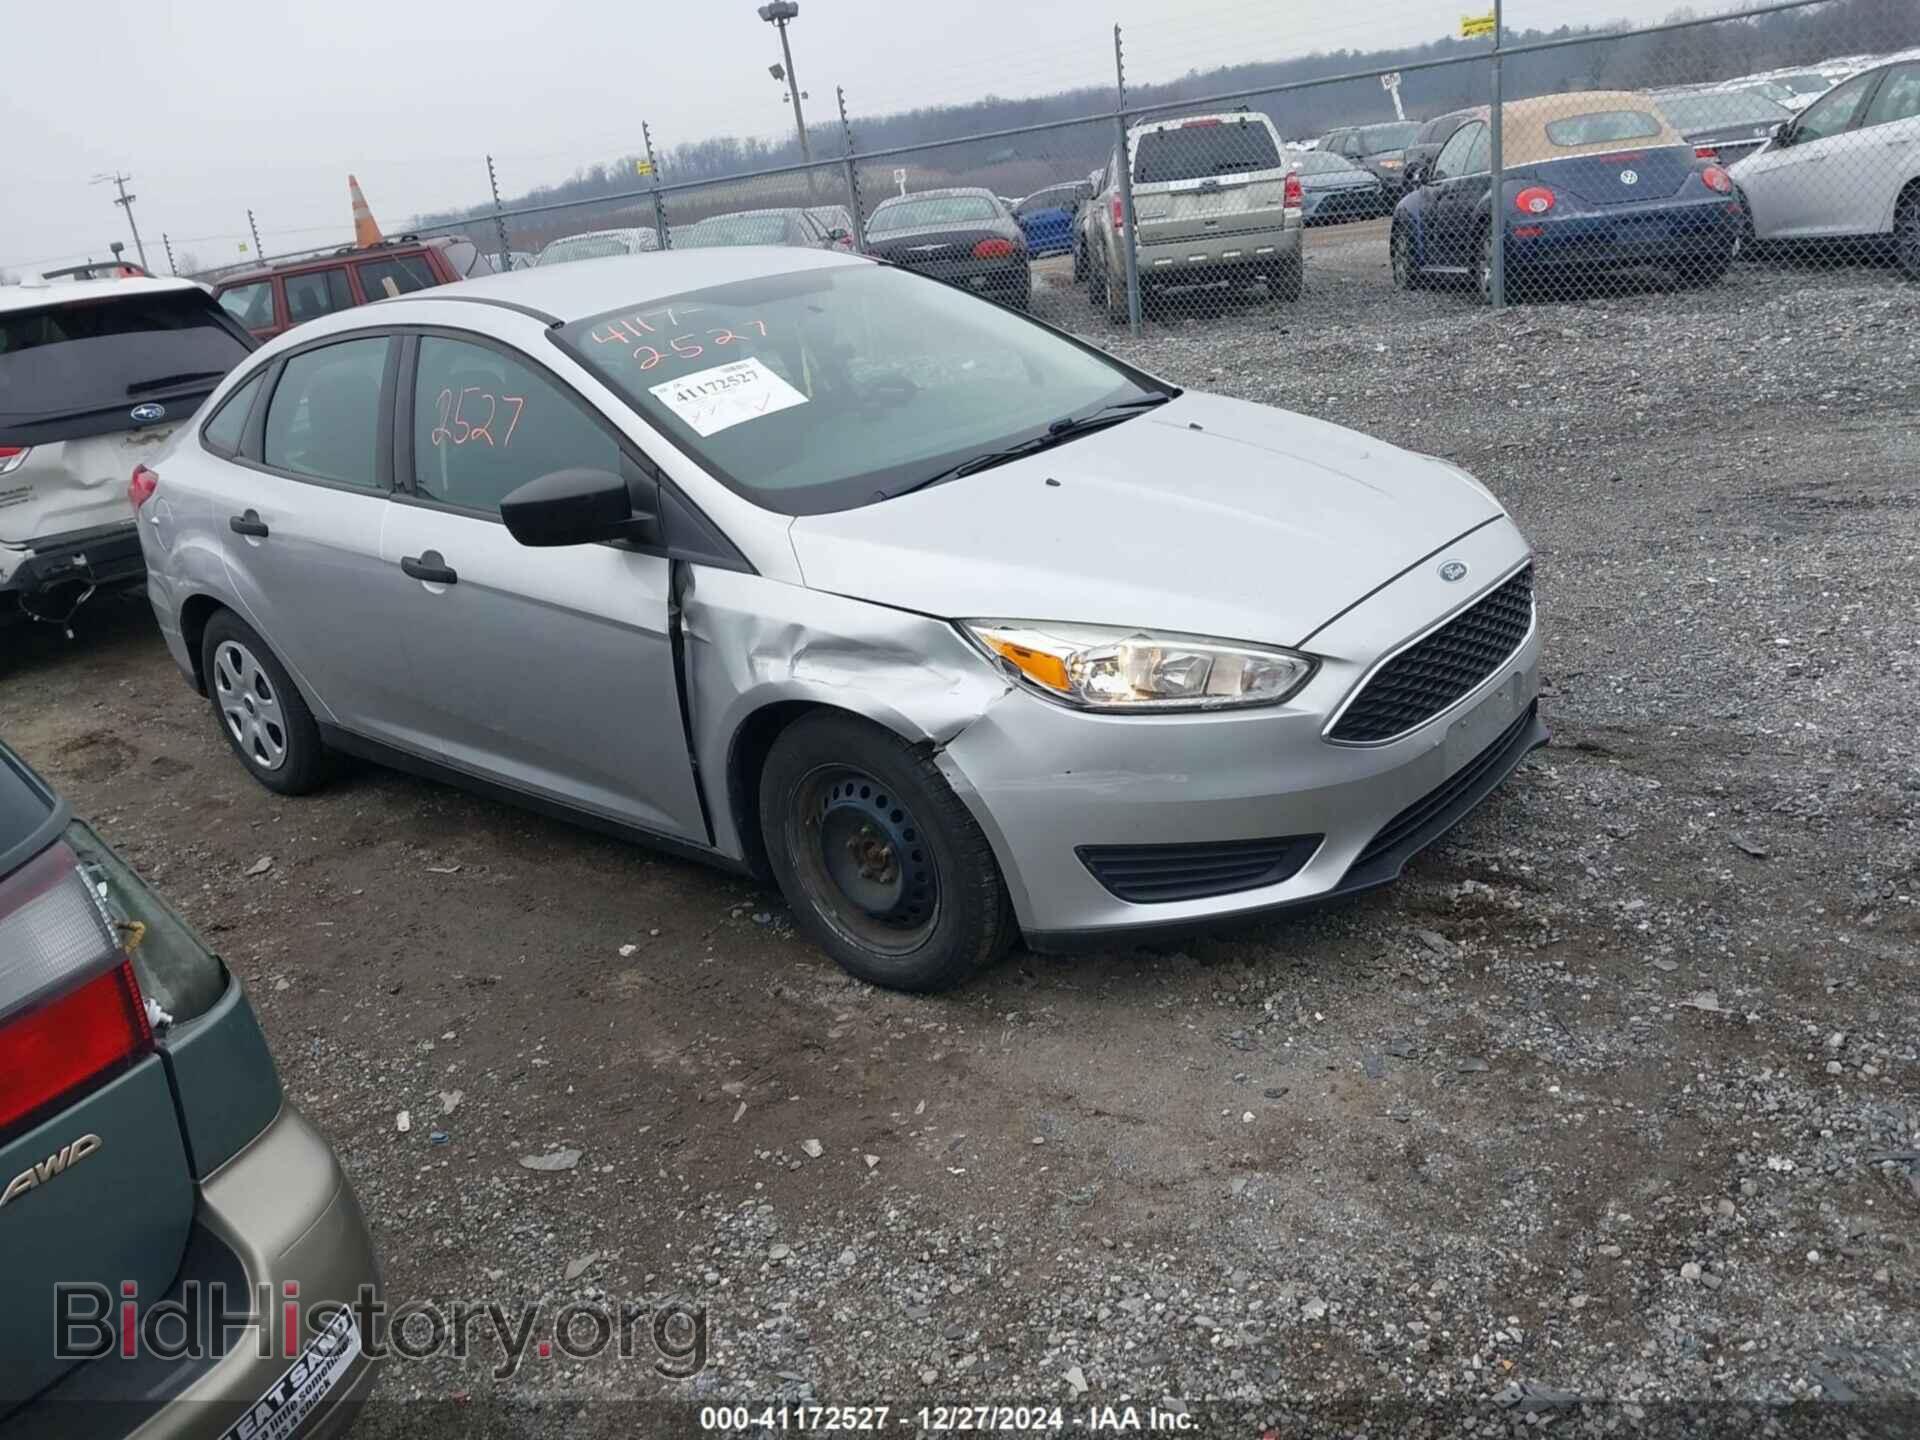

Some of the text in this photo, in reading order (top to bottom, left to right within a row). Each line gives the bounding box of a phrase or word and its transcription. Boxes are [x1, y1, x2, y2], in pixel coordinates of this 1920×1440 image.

[633, 319, 767, 370] 2527
[675, 370, 759, 403] 41172527
[432, 388, 523, 446] 2527
[0, 1133, 103, 1206] AWD
[236, 1315, 349, 1440] EAT SAND
